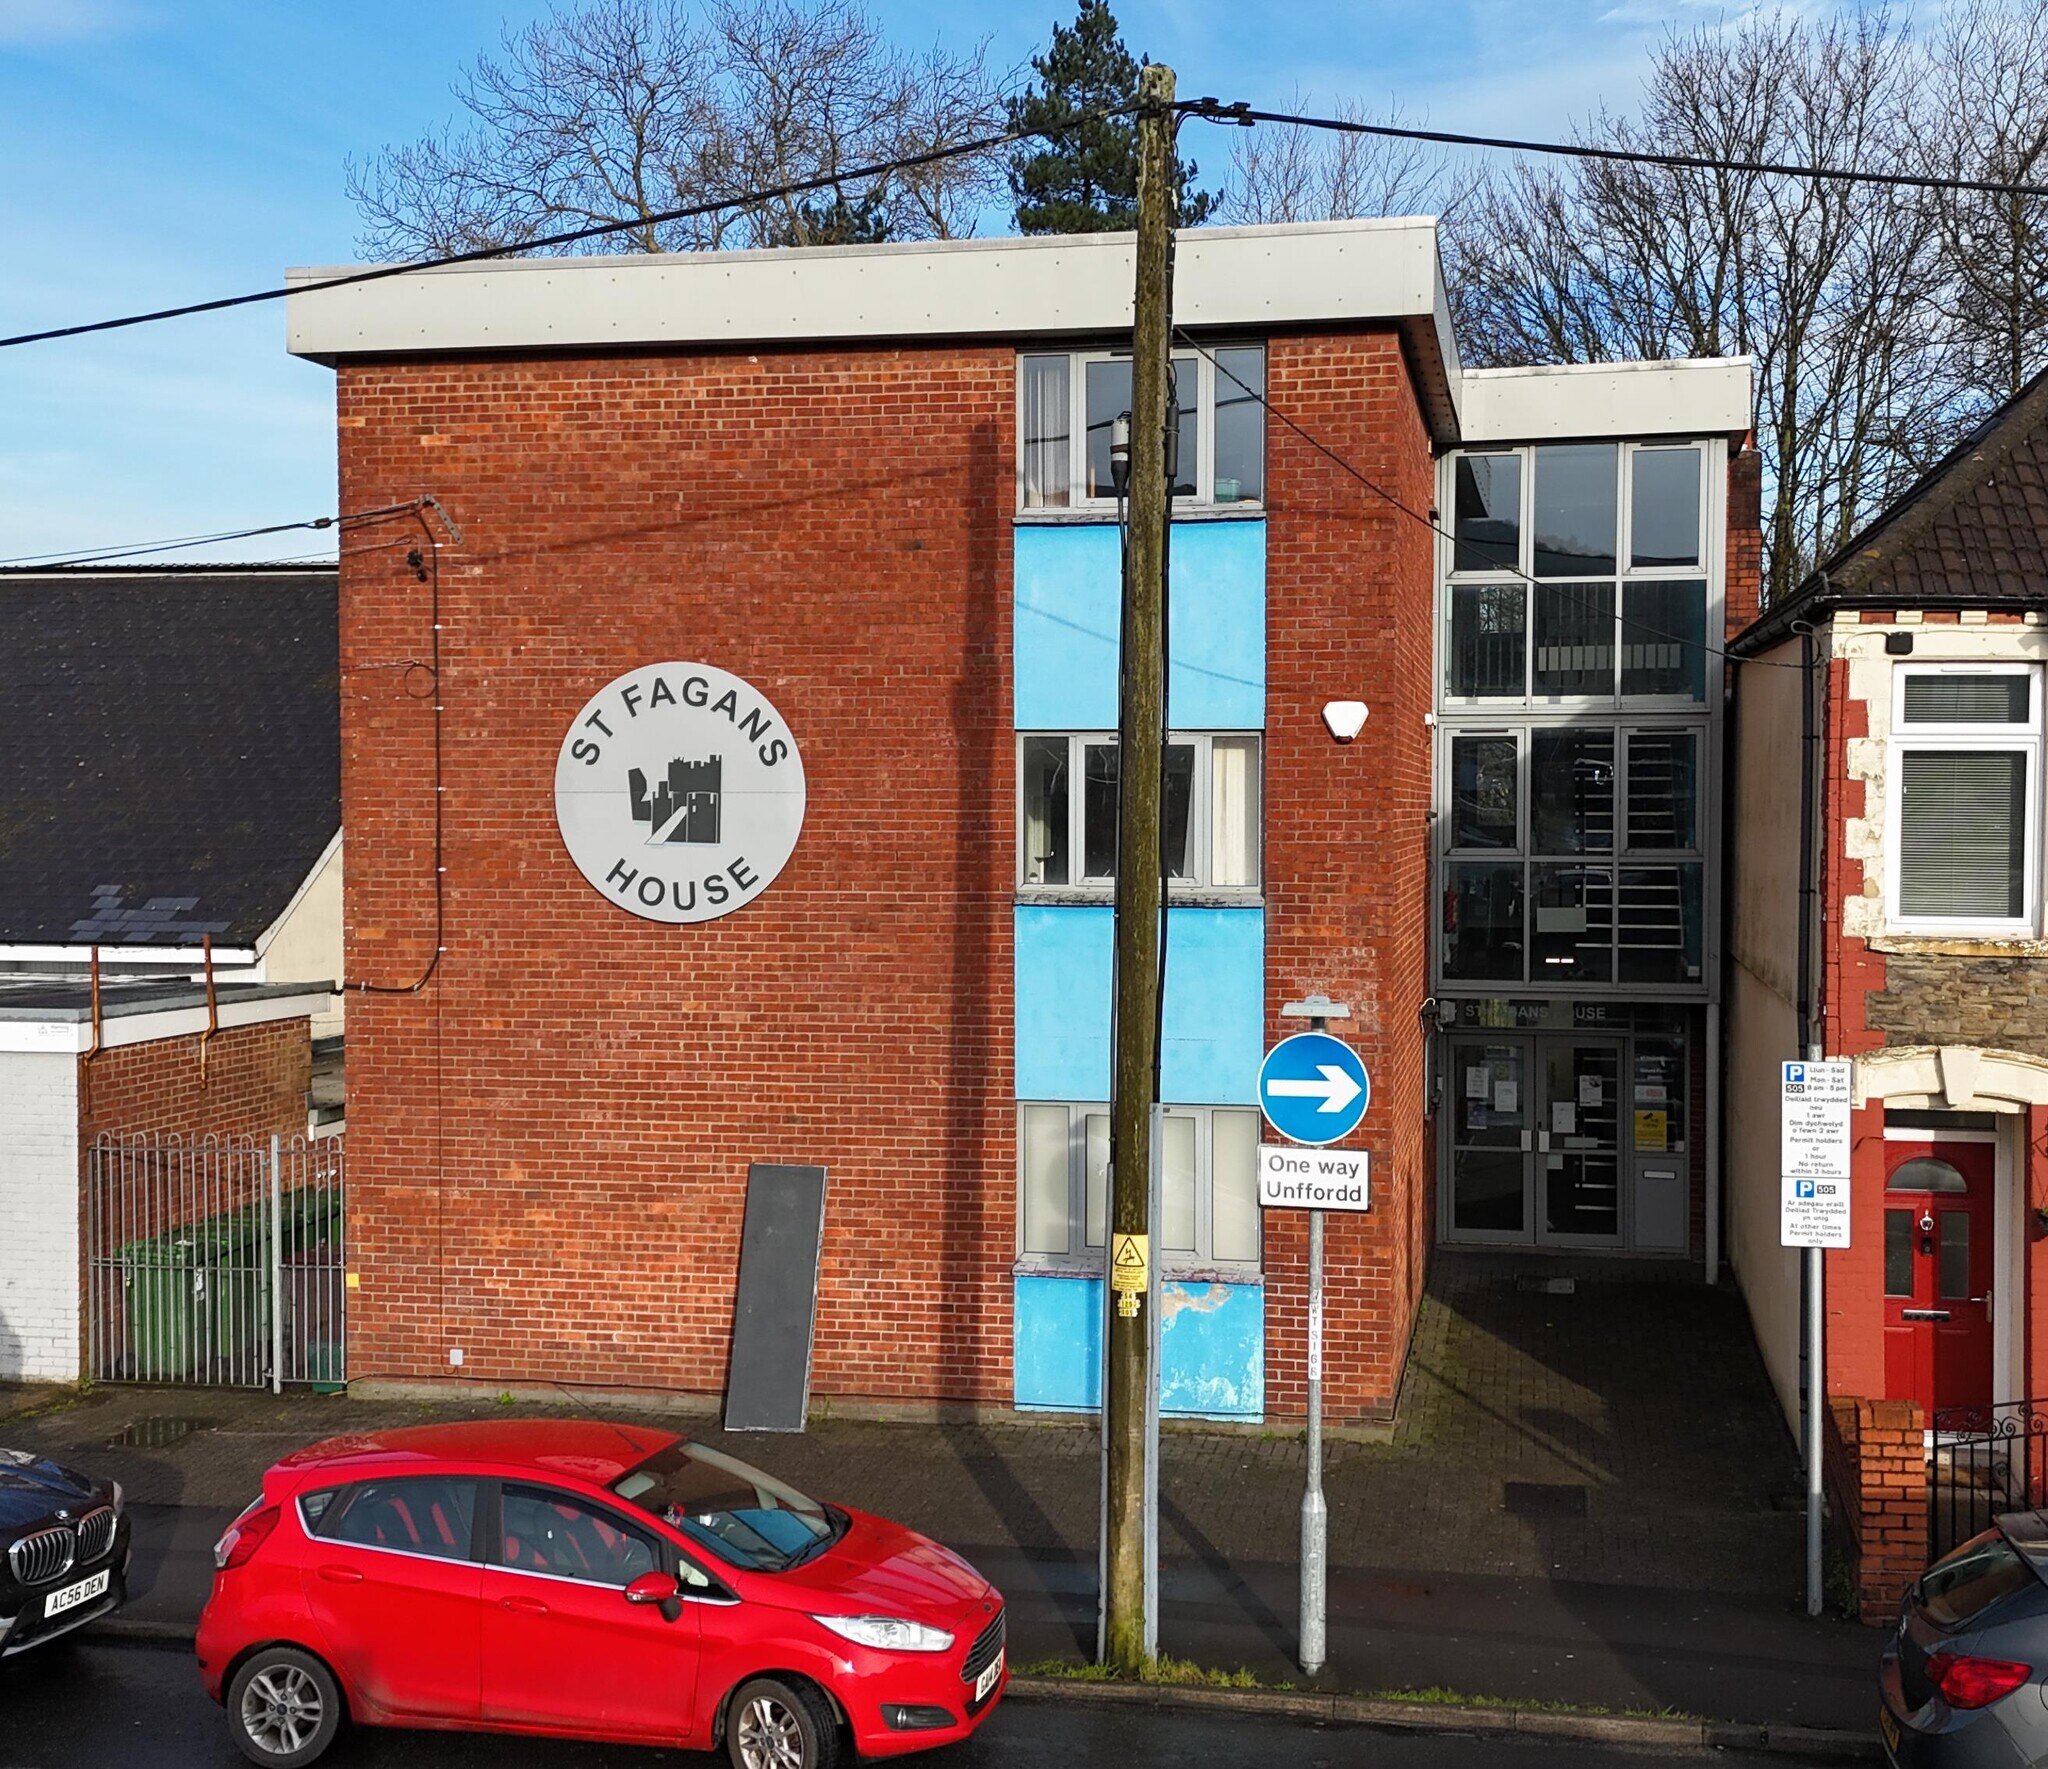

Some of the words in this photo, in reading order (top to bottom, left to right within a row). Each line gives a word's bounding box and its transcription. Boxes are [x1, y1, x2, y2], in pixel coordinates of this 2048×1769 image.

[571, 708, 613, 766] ST
[621, 677, 788, 767] FAGANS
[605, 856, 759, 911] HOUSE
[1790, 1065, 1803, 1081] P
[1268, 1155, 1310, 1173] One
[1318, 1161, 1359, 1179] way
[1266, 1181, 1361, 1202] Unffordd
[1800, 1181, 1813, 1197] P
[51, 1587, 81, 1611] AC56
[84, 1575, 104, 1596] DEN
